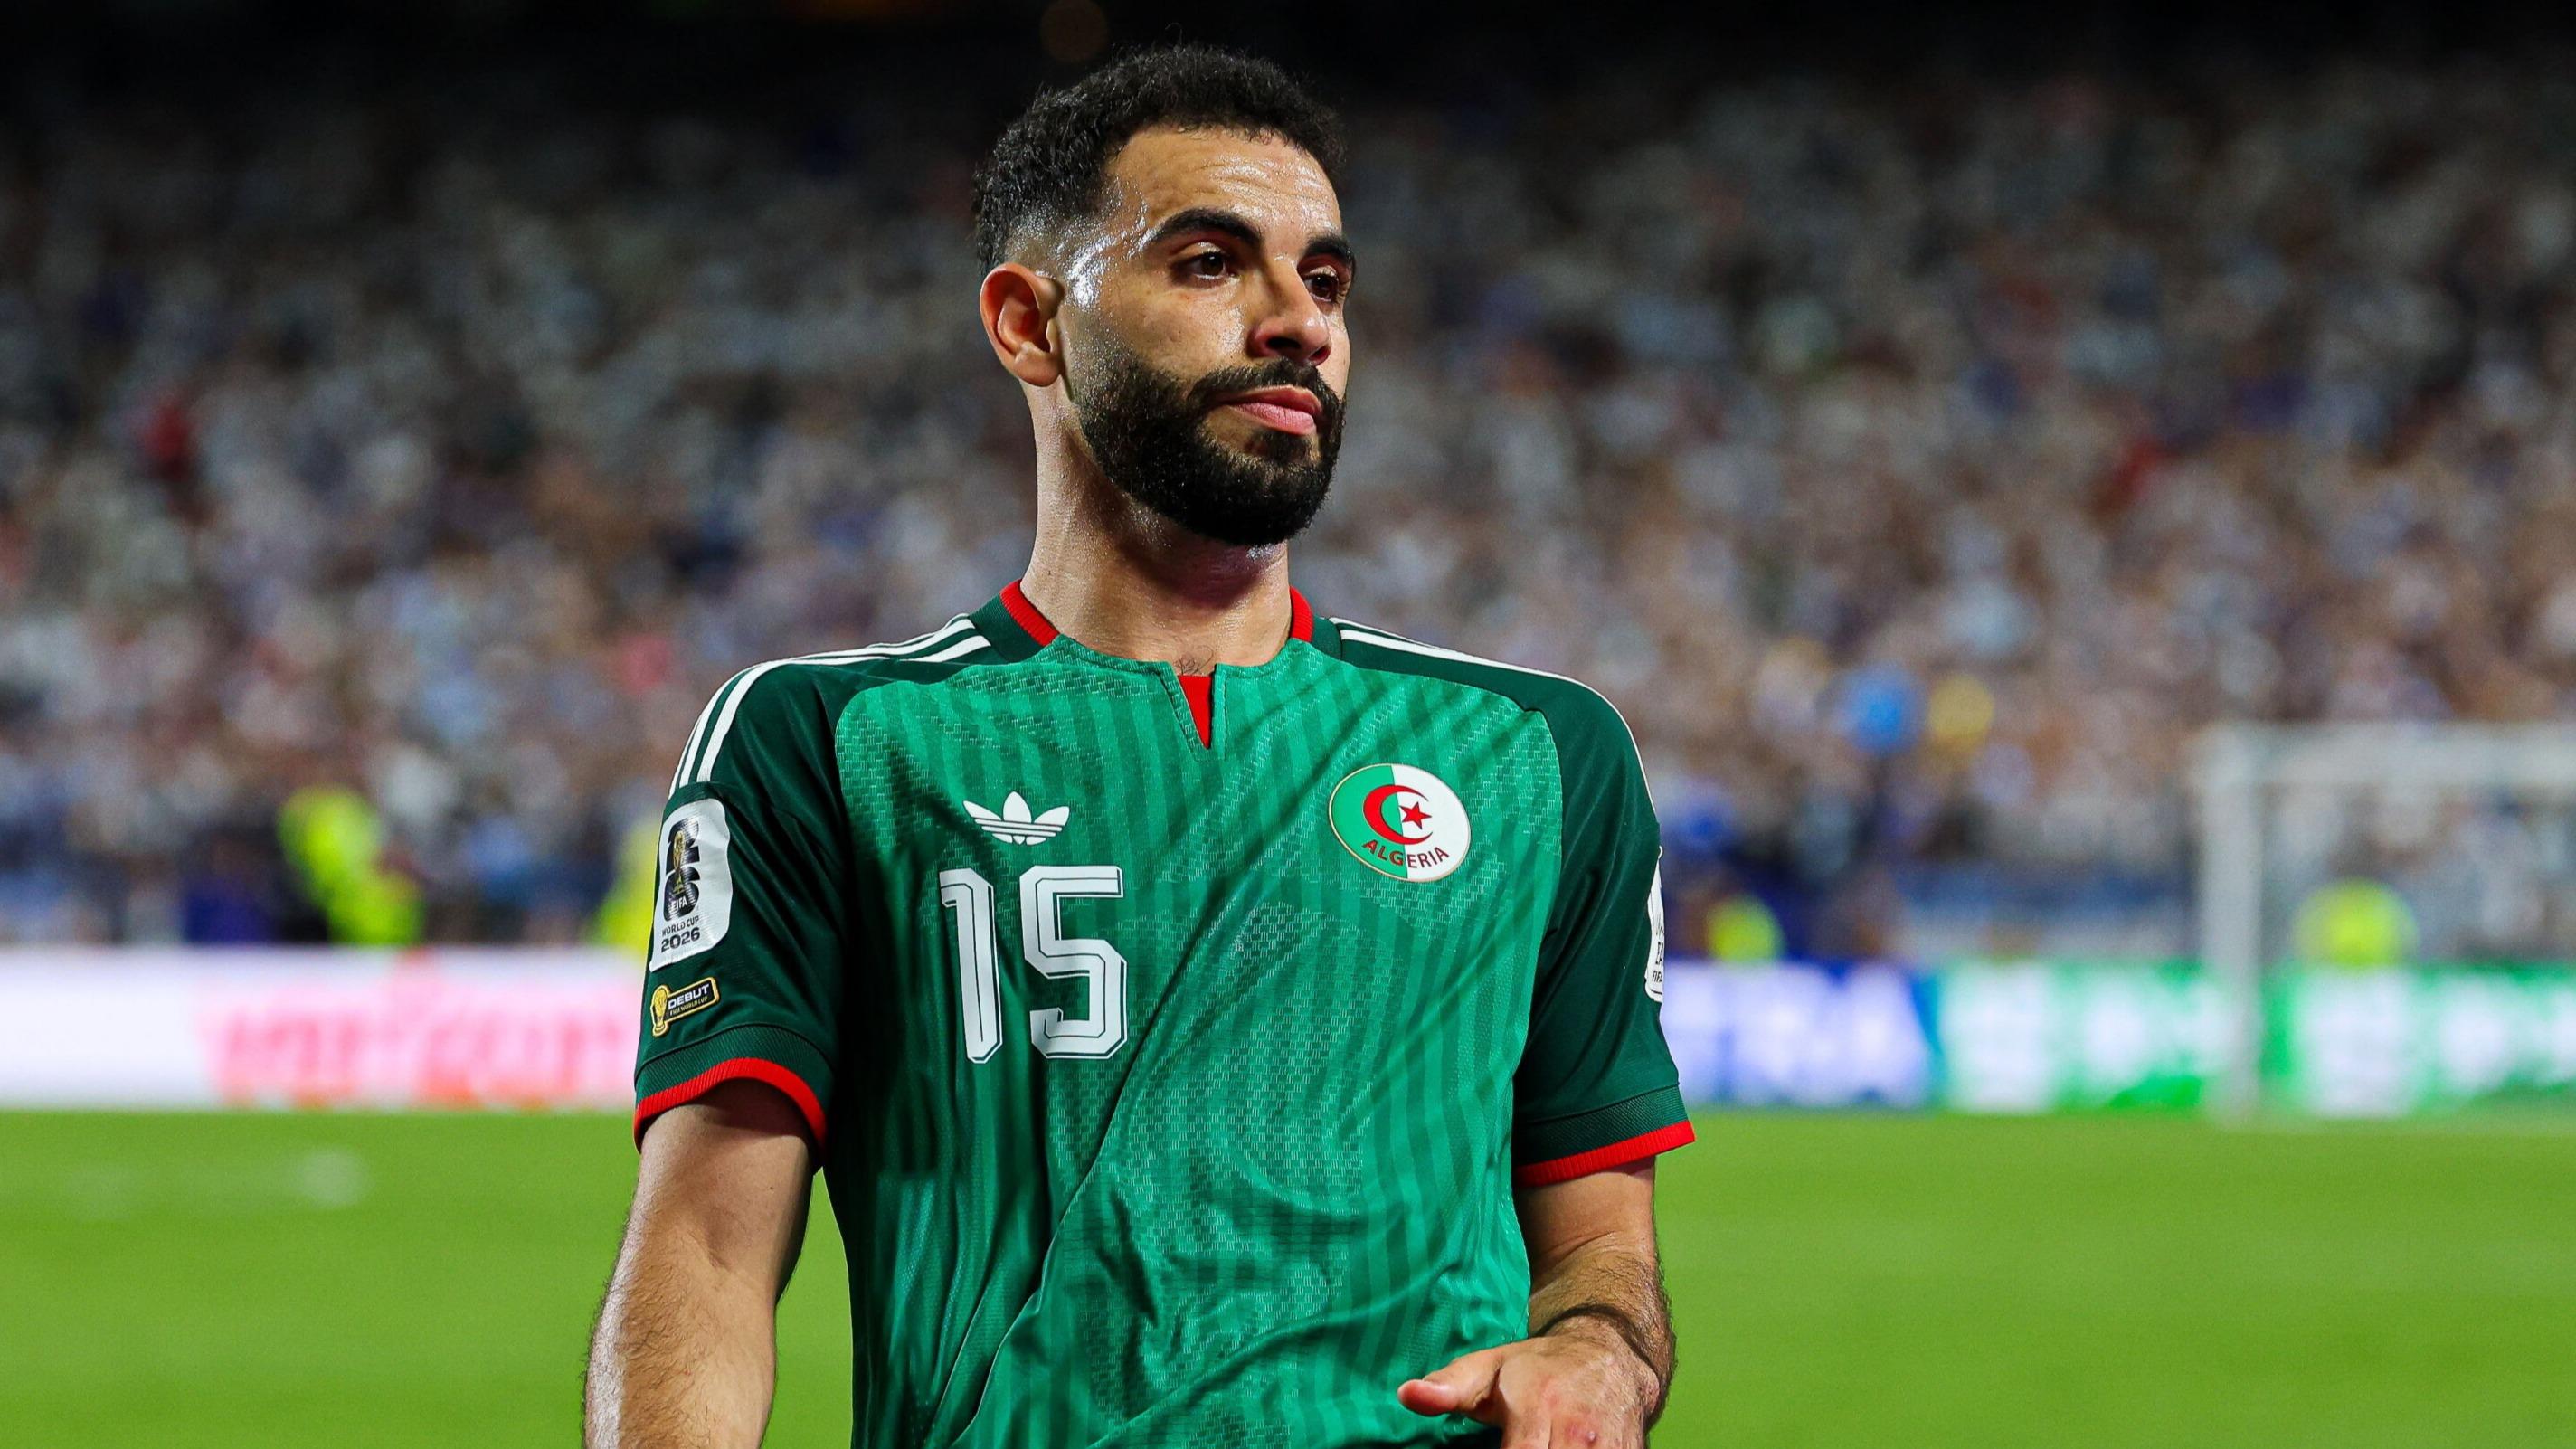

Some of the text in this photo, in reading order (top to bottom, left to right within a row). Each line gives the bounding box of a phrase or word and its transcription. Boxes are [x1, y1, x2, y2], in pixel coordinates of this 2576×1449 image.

[1361, 839, 1450, 869] ALGERIA
[661, 926, 701, 953] 2026
[662, 915, 700, 937] WORLD CUP
[939, 865, 1128, 1065] 15
[668, 984, 709, 1009] DEBUT
